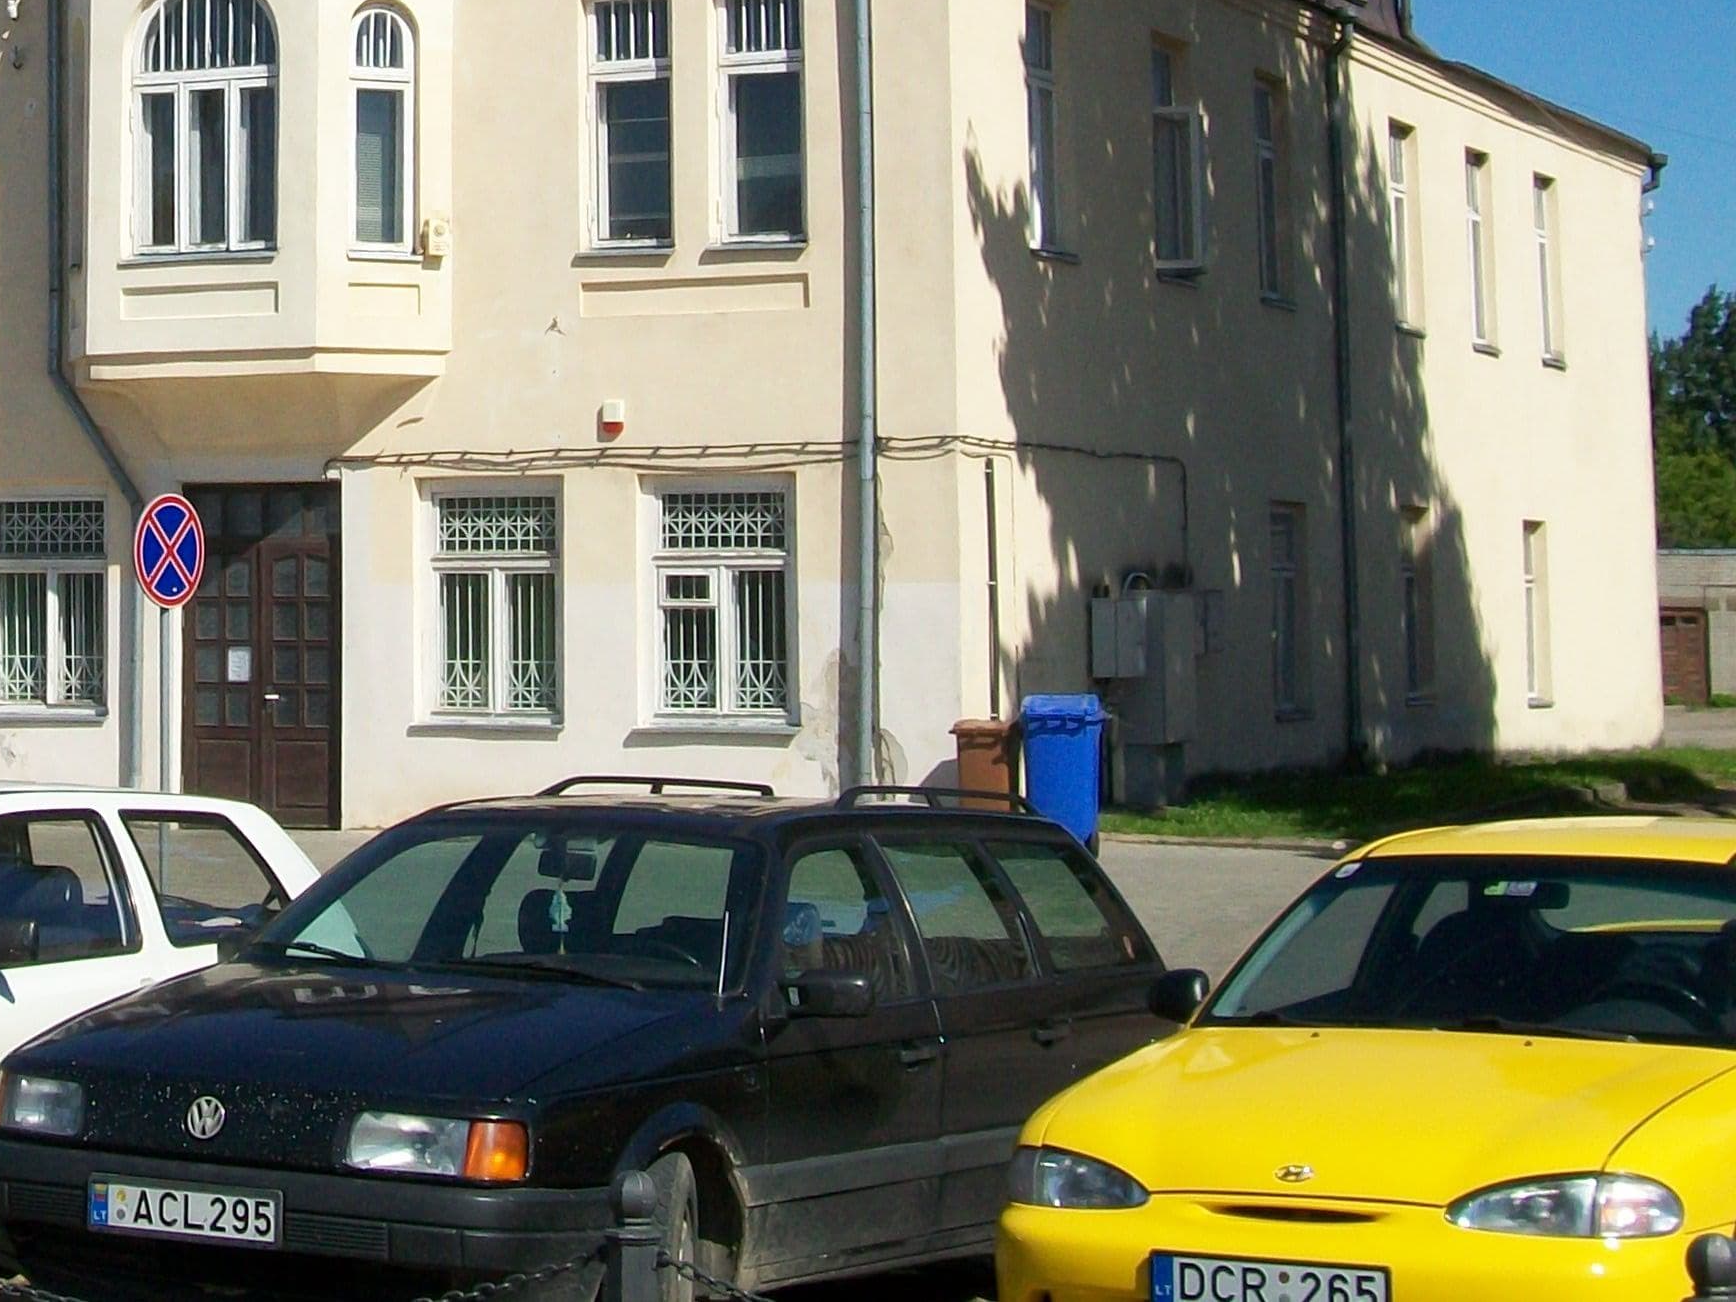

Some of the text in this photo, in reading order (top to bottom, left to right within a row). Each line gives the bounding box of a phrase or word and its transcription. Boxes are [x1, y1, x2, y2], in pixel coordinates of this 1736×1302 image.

[93, 1209, 107, 1220] LT
[133, 1190, 272, 1236] ACL295
[1155, 1284, 1172, 1295] LT
[1179, 1262, 1379, 1302] DCR 265
